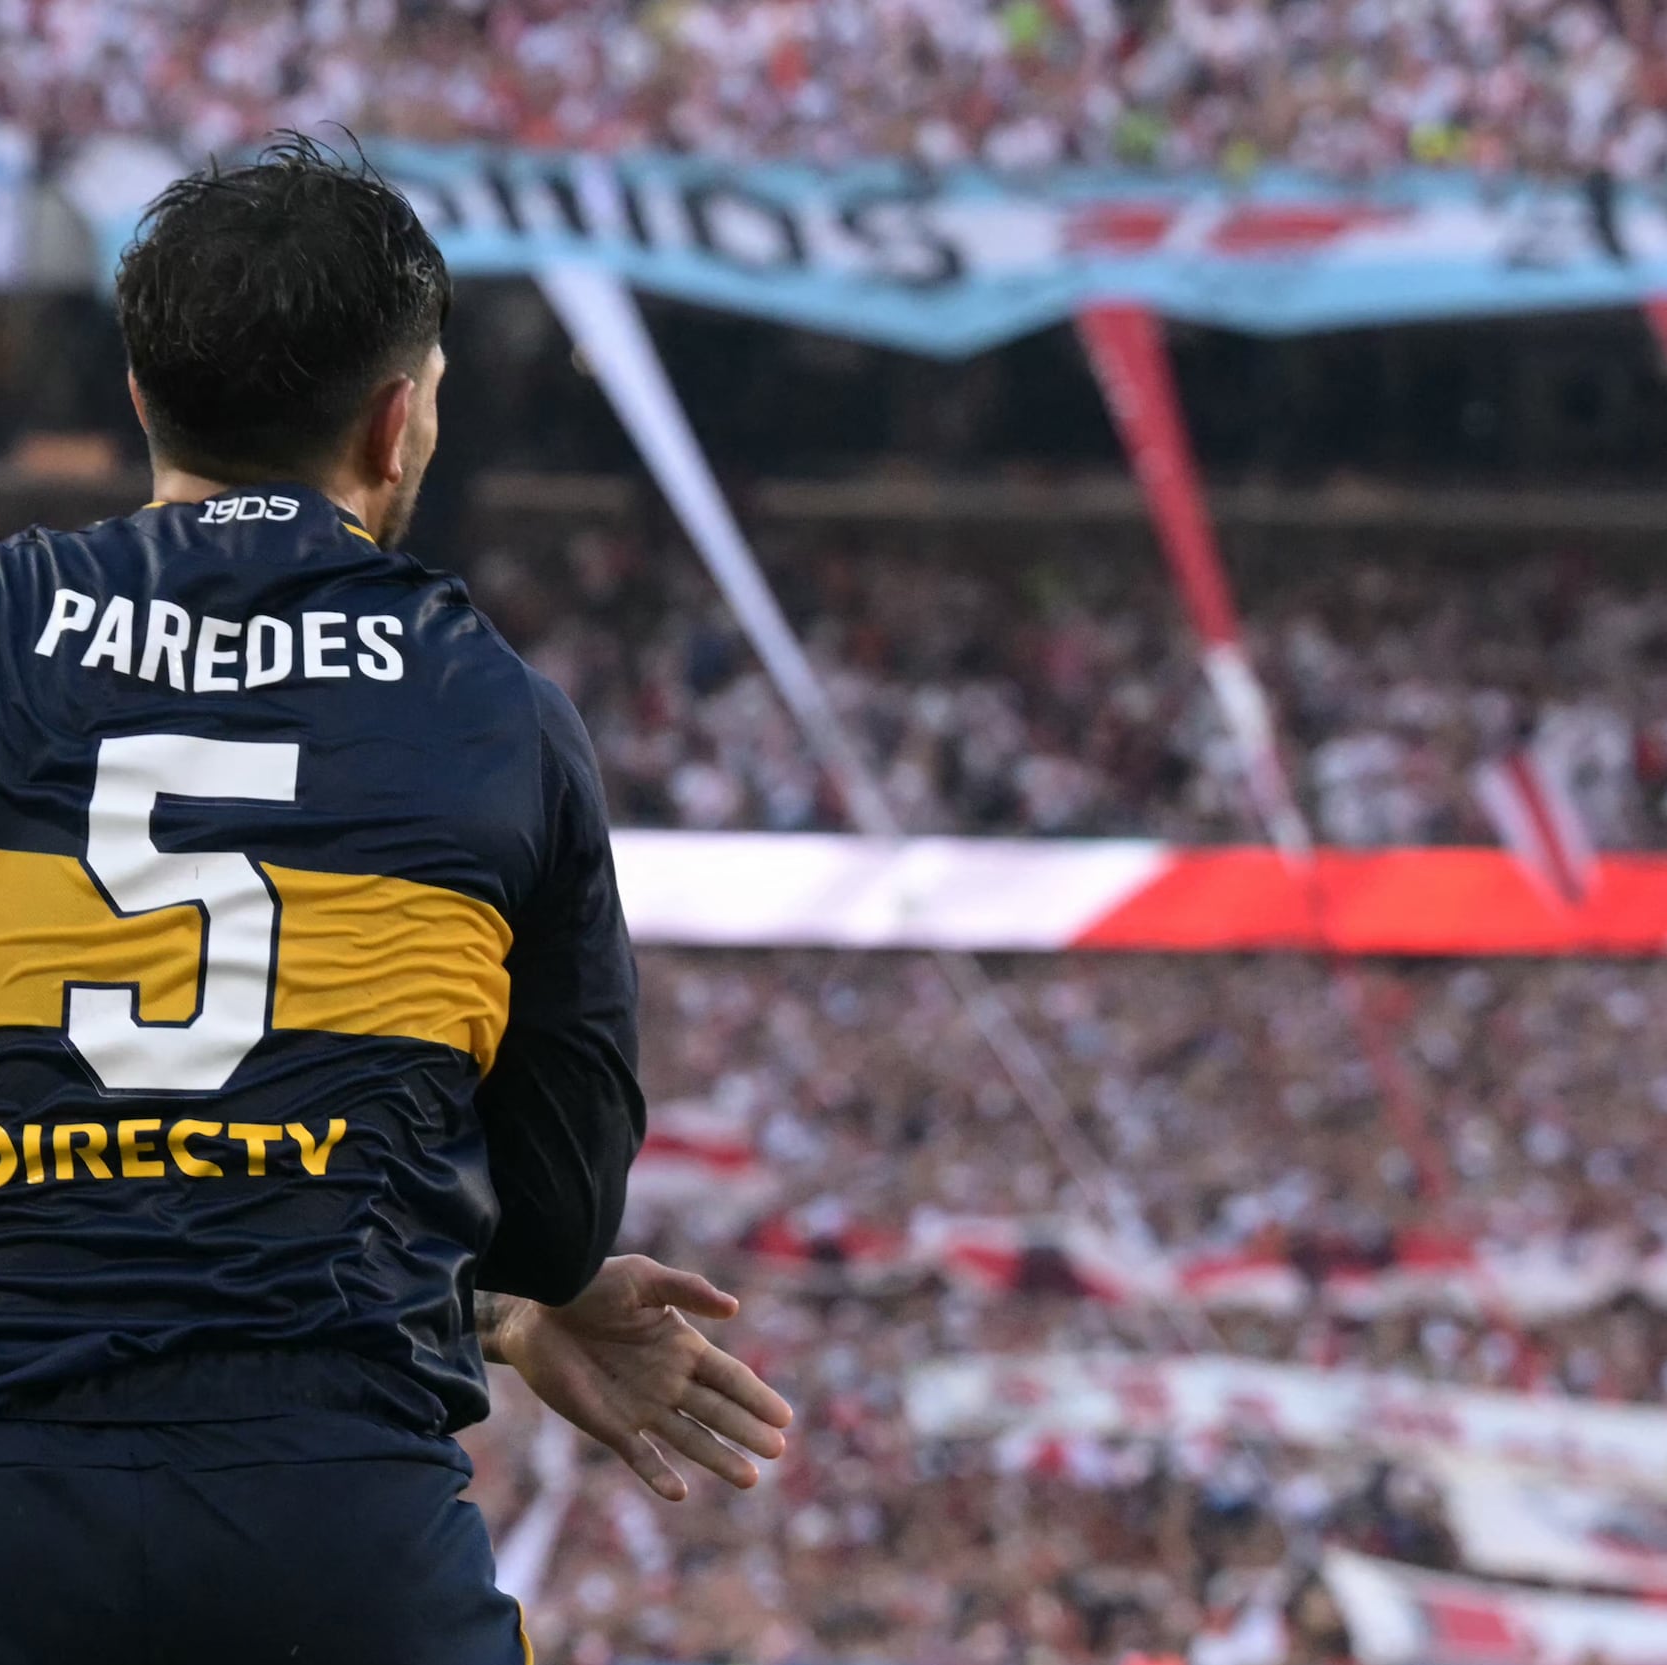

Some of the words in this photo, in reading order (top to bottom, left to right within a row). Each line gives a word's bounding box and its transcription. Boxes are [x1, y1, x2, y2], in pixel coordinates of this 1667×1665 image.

[198, 495, 300, 524] 1905
[34, 588, 404, 693] PAREDES
[67, 733, 300, 1091] 5
